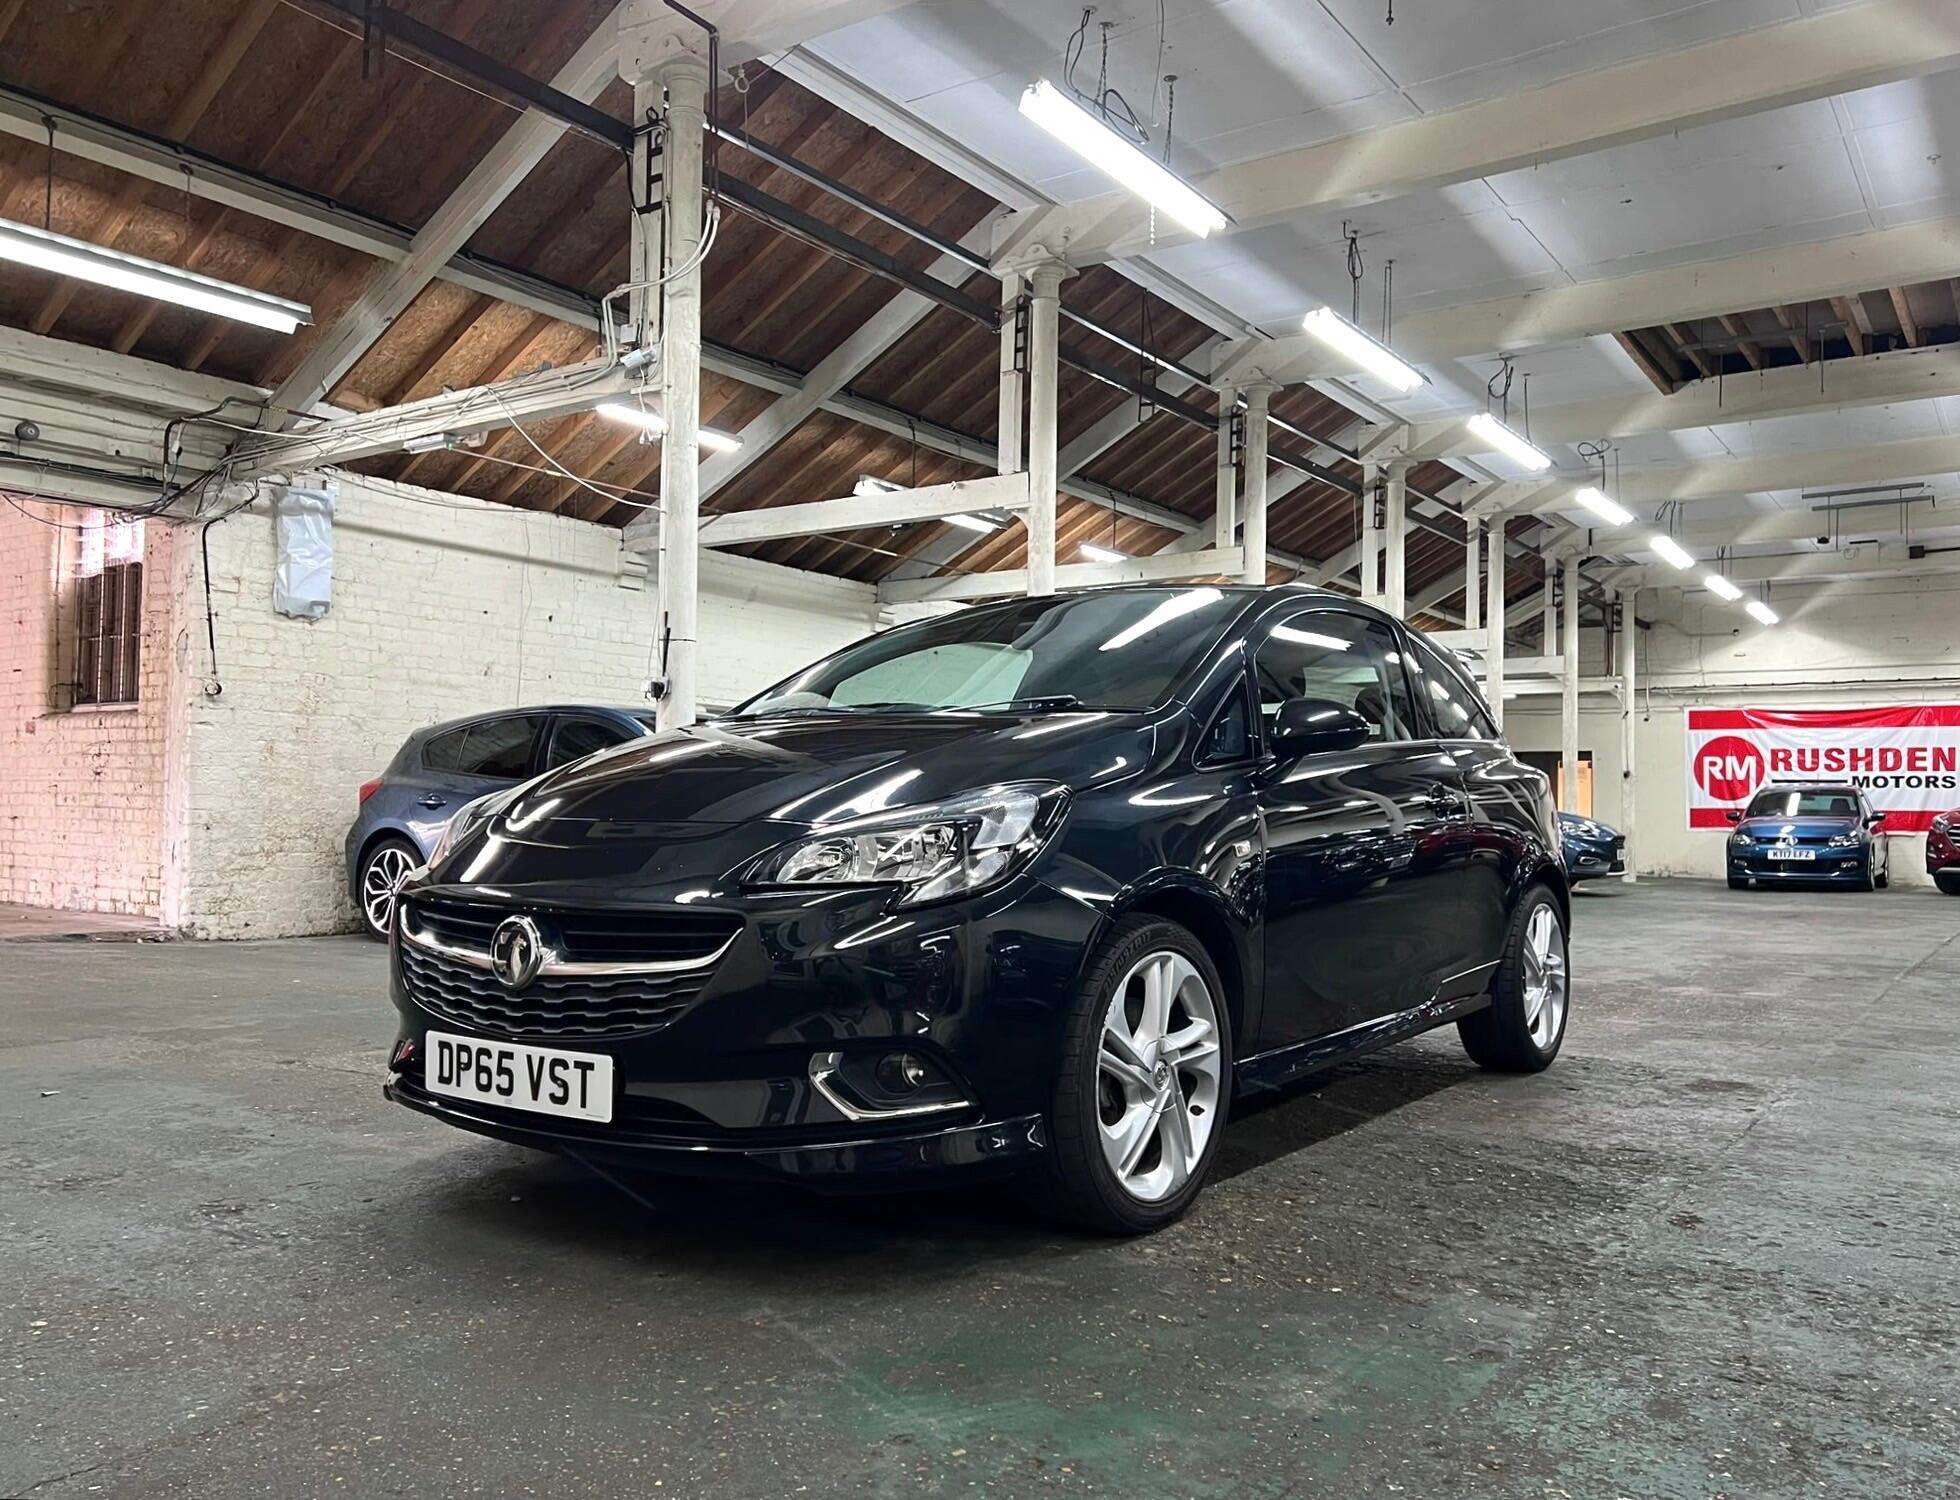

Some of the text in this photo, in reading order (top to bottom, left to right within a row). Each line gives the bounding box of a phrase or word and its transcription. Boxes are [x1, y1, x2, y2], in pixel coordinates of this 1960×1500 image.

[1703, 755, 1757, 792] RM
[1770, 747, 1956, 772] RUSHDEN
[1851, 775, 1957, 789] MOTORS
[437, 1040, 595, 1109] DP65 VST
